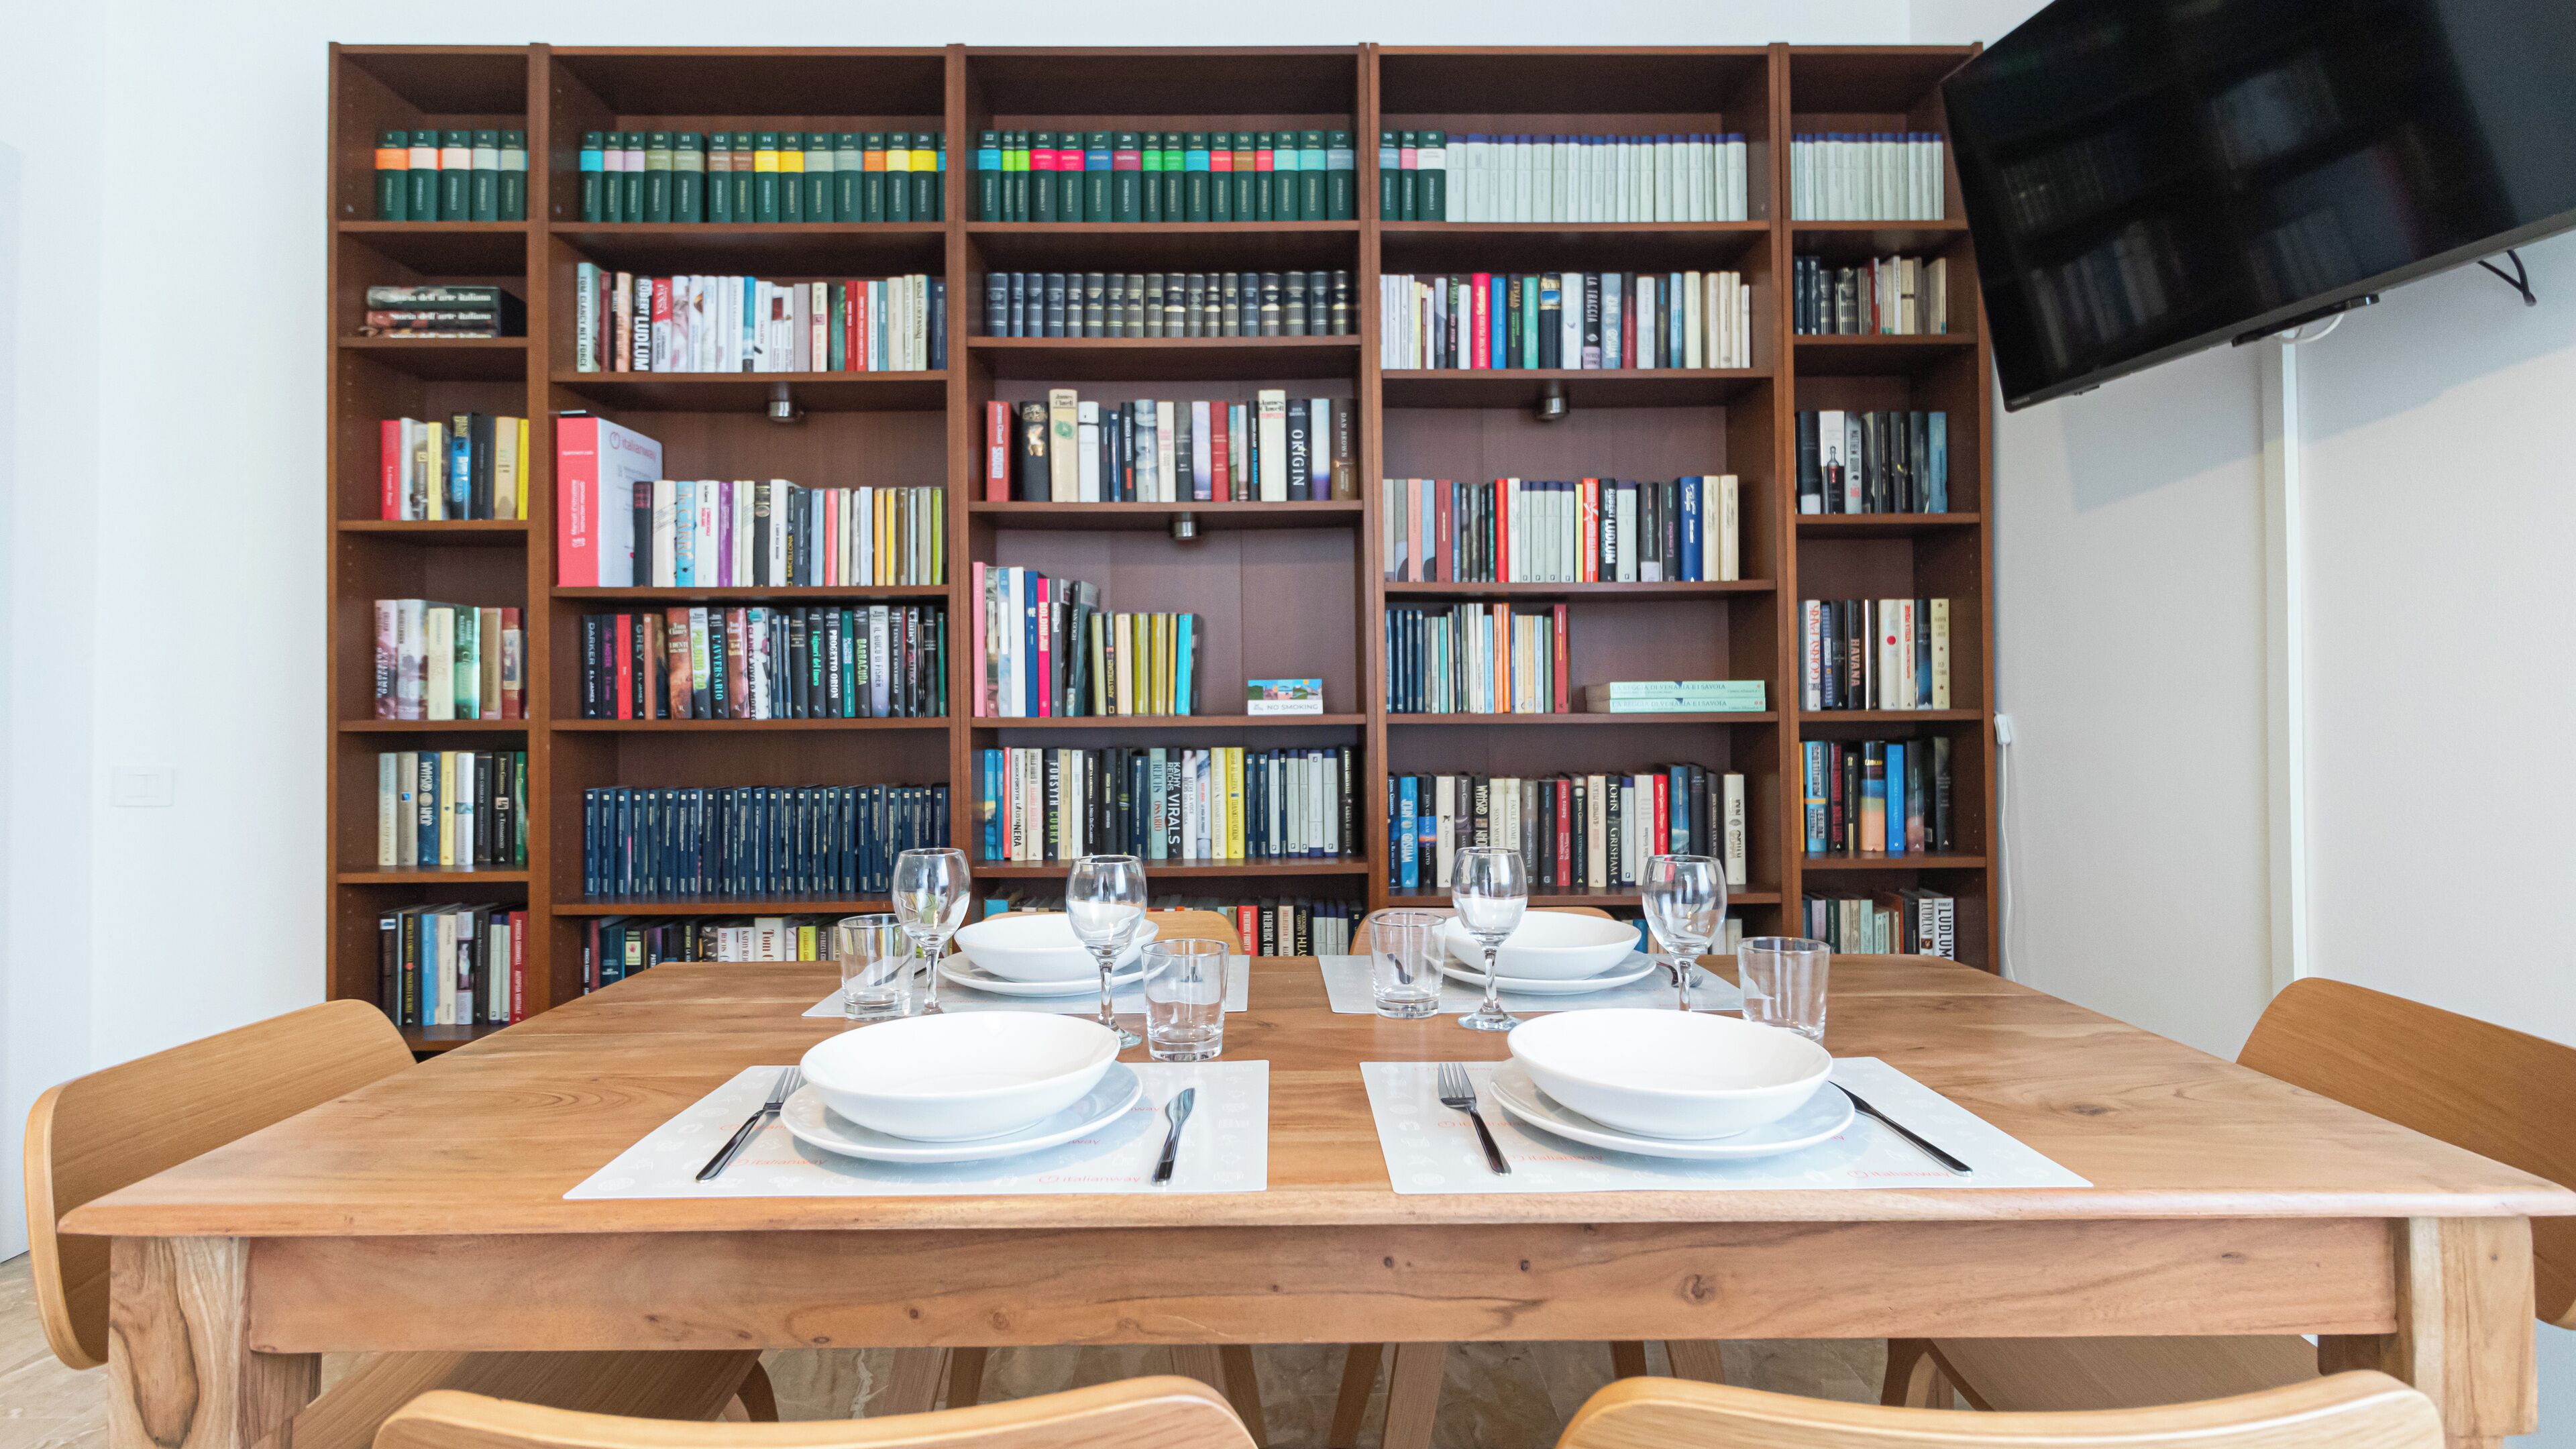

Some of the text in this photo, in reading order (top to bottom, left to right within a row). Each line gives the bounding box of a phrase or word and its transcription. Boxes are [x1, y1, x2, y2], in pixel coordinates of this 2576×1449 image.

[656, 284, 665, 315] PANSA
[1587, 276, 1597, 323] LA TRACCIA
[580, 276, 588, 367] TOM CLANCY NET FORCE
[635, 279, 650, 371] ROBERT LUDLUM
[621, 439, 657, 461] italianway
[1291, 429, 1305, 486] ORIGIN
[1605, 488, 1615, 564] ROBERT LUDLUM
[1667, 549, 1674, 557] La
[906, 612, 917, 645] Clancy
[1039, 601, 1048, 635] BOLDINI
[636, 624, 644, 661] GREY
[692, 629, 704, 670] POLONIO
[857, 638, 867, 685] BARRACUDA
[874, 635, 882, 653] GIOCO
[1809, 604, 1820, 680] GORKY PARK
[712, 634, 723, 700] L'AVVERSARIO
[829, 629, 839, 698] PROGETTO ORION
[874, 665, 883, 688] FISHER
[1106, 659, 1114, 698] AMSTERDAM
[1851, 638, 1860, 686] HAVANA
[419, 761, 433, 826] JOHN GRISHAM
[1015, 802, 1022, 810] LA
[1049, 761, 1059, 843] FORSYTH COBRA
[1153, 763, 1164, 831] REICHS OSSARIO
[1014, 824, 1022, 846] NERA
[1168, 793, 1180, 844] VIRALS
[1401, 798, 1413, 862] JOHN GRISHAM
[1475, 786, 1488, 847] JOHN GRISHAM
[1608, 784, 1619, 875] JOHN GRISHAM
[1242, 911, 1250, 932] FREDERICK
[1262, 911, 1272, 944] FREDERICK
[1921, 902, 1932, 934] LUDLUM
[1938, 908, 1952, 957] LUDLUM
[741, 930, 750, 948] KATHY
[762, 928, 775, 951] Tom
[750, 1158, 825, 1167] italianway
[1527, 1154, 1602, 1163] italianway
[1872, 1170, 1950, 1178] italianway
[1060, 1175, 1140, 1184] italianway
